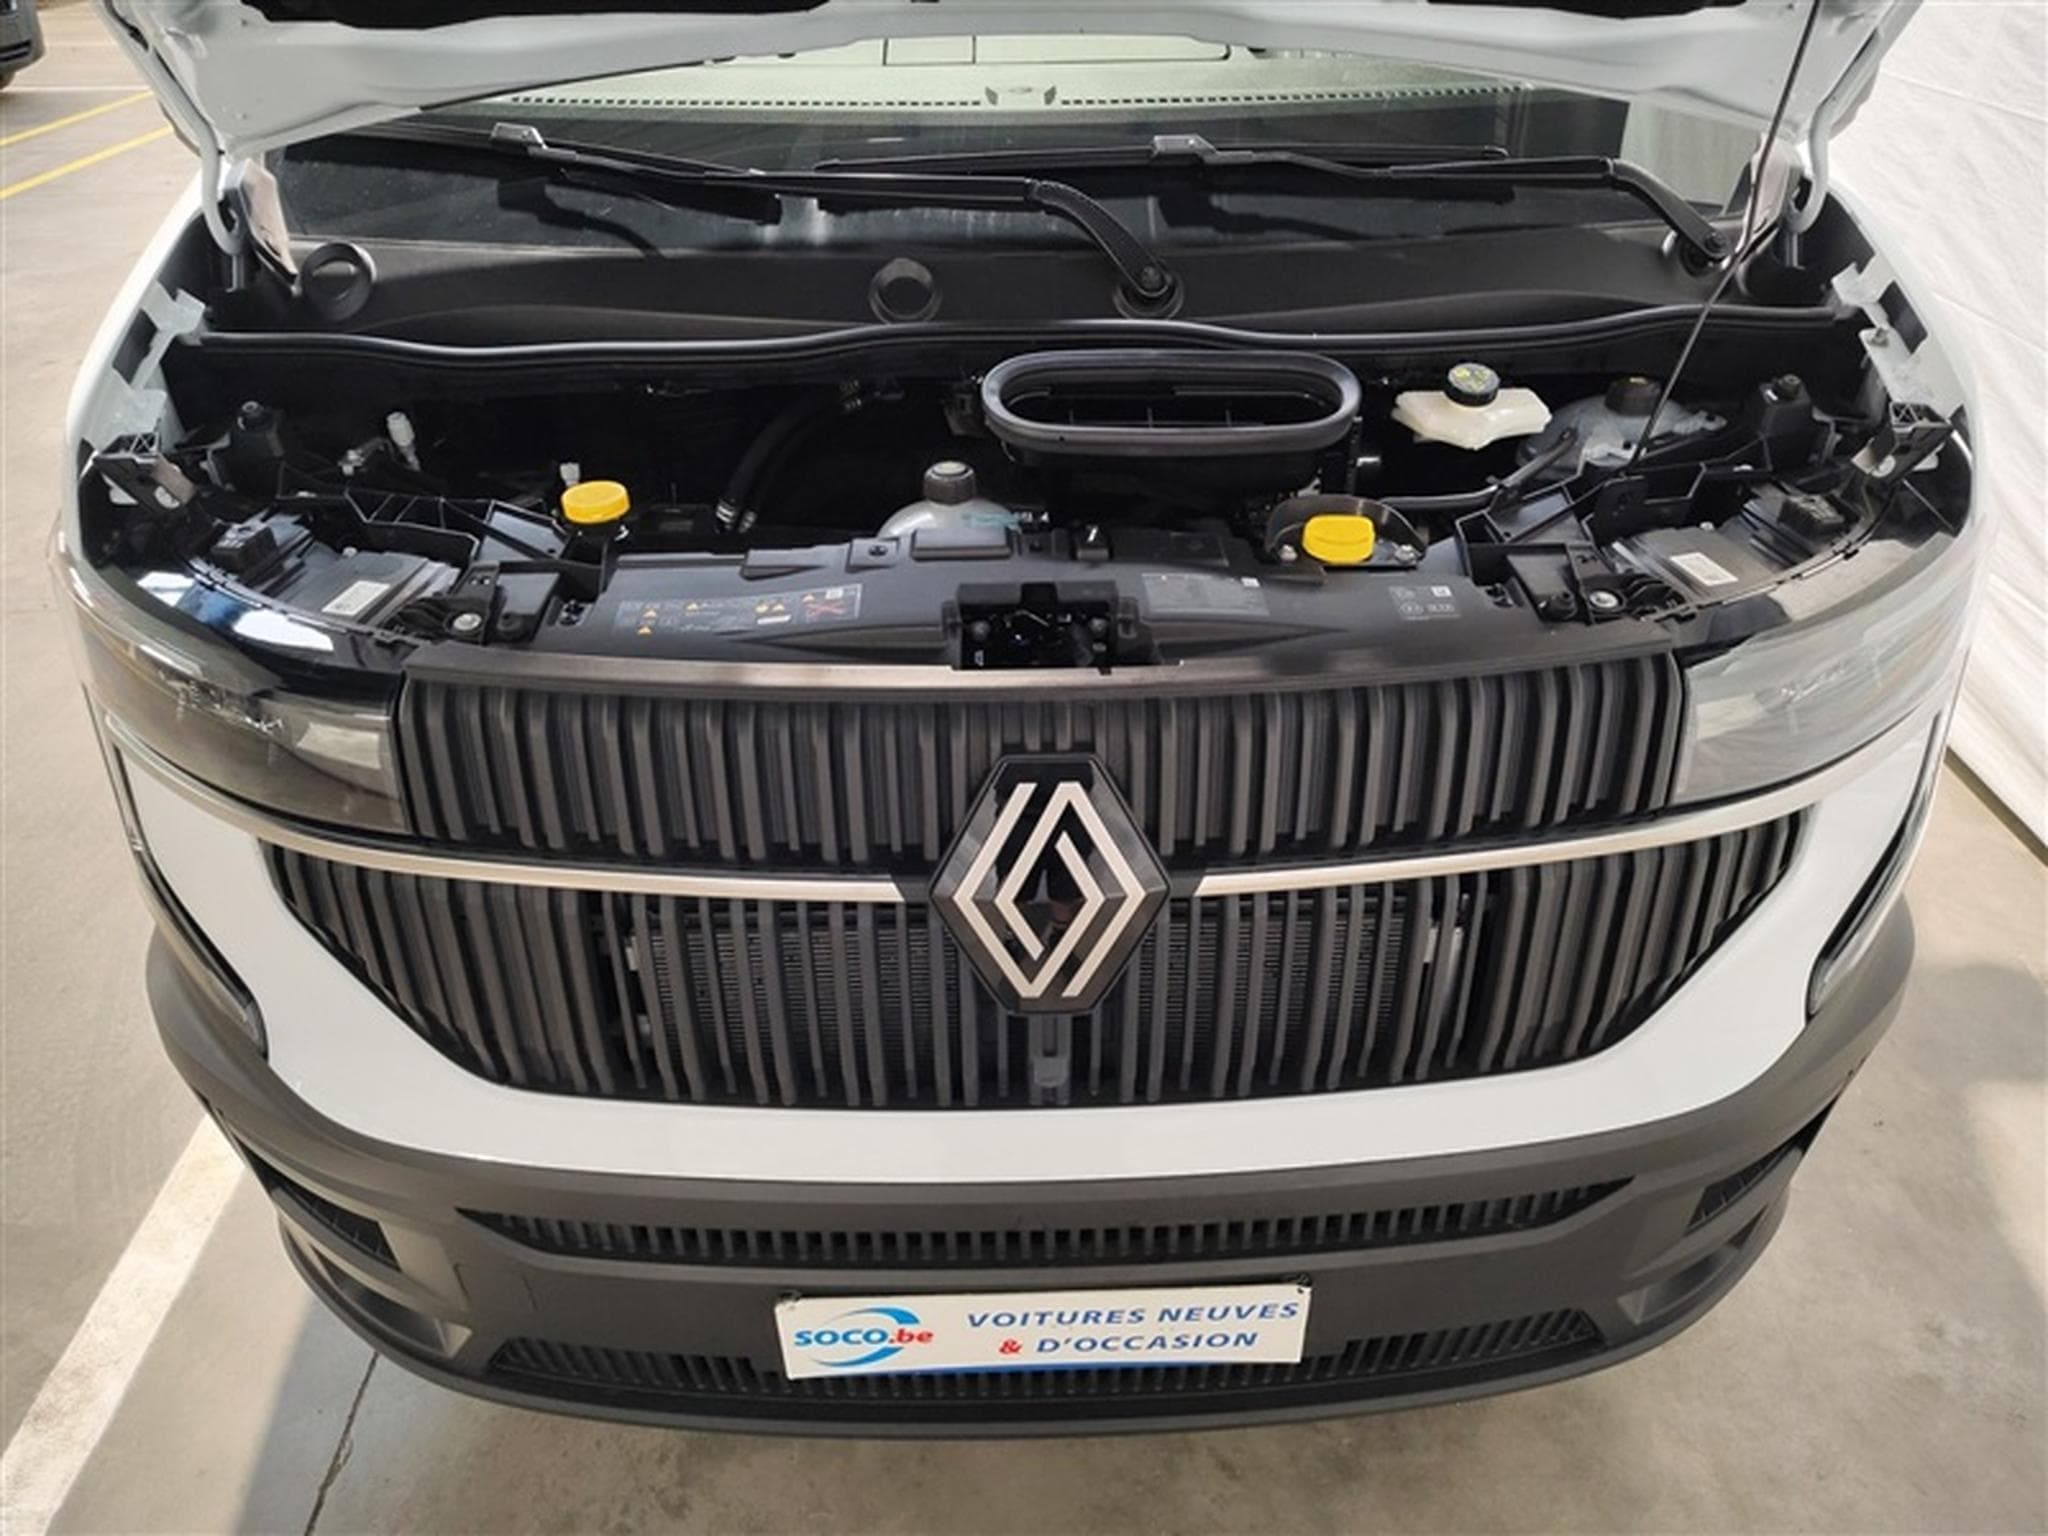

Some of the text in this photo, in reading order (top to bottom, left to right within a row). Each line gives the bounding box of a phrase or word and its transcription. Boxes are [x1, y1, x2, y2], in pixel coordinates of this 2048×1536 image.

[967, 1302, 1298, 1328] VOITURES NEUVES
[999, 1332, 1257, 1354] & D'OCCASION
